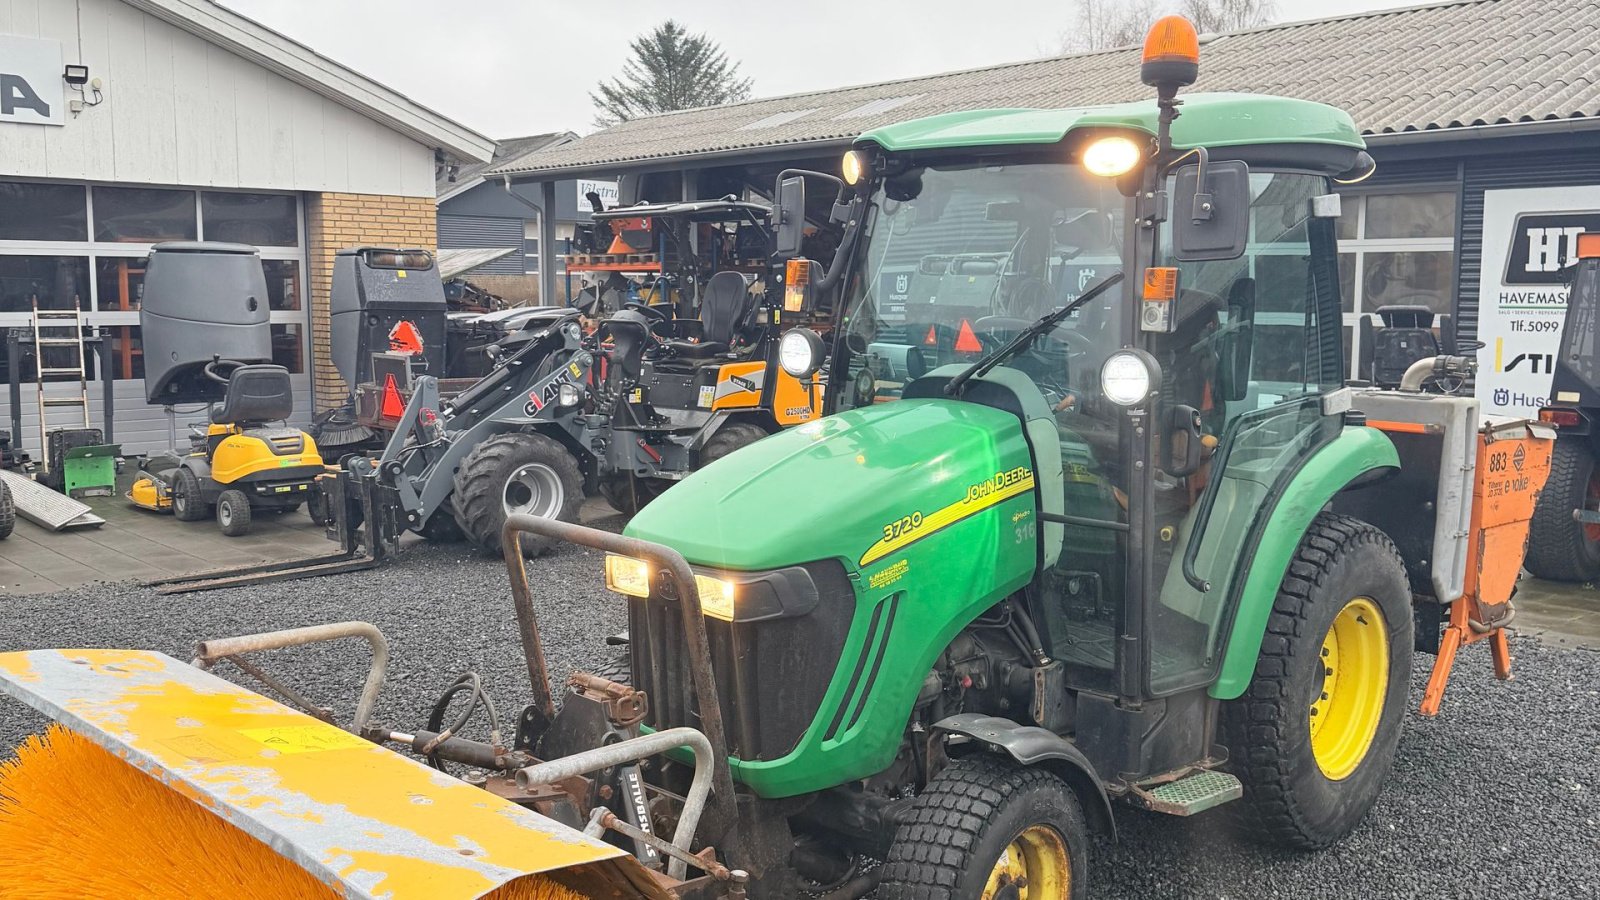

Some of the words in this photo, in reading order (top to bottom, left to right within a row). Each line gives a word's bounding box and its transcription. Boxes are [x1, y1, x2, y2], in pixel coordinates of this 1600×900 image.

[1510, 320, 1560, 333] Tlf.5099
[1489, 452, 1507, 472] 883
[963, 481, 995, 504] JOHN
[994, 466, 1033, 492] DEERE
[883, 511, 923, 543] 3720
[1015, 522, 1035, 544] 316
[629, 773, 656, 858] STNSBALLE
